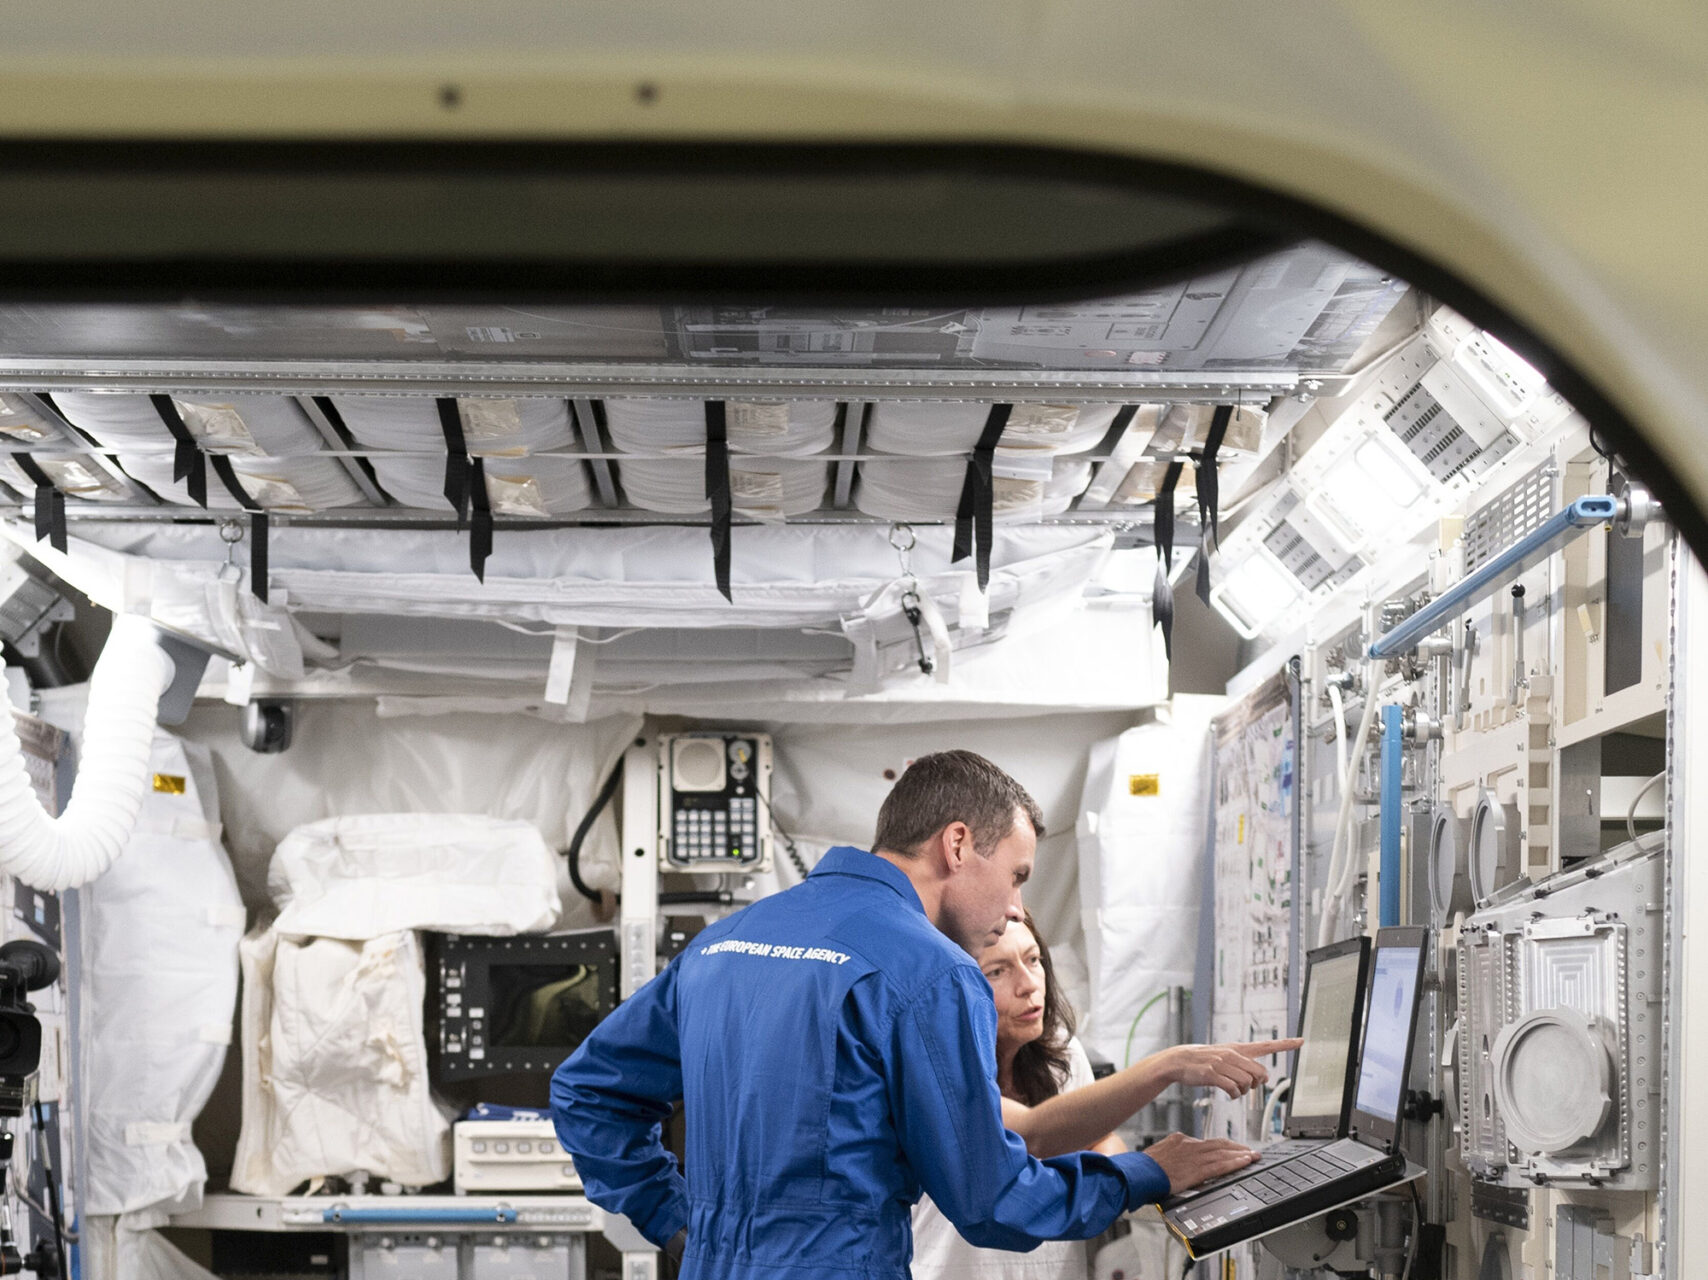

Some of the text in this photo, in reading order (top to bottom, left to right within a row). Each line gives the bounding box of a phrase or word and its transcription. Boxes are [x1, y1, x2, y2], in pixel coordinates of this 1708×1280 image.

[719, 939, 772, 957] EUROPEAN
[770, 945, 805, 960] SPACE
[802, 947, 851, 966] AGENCY
